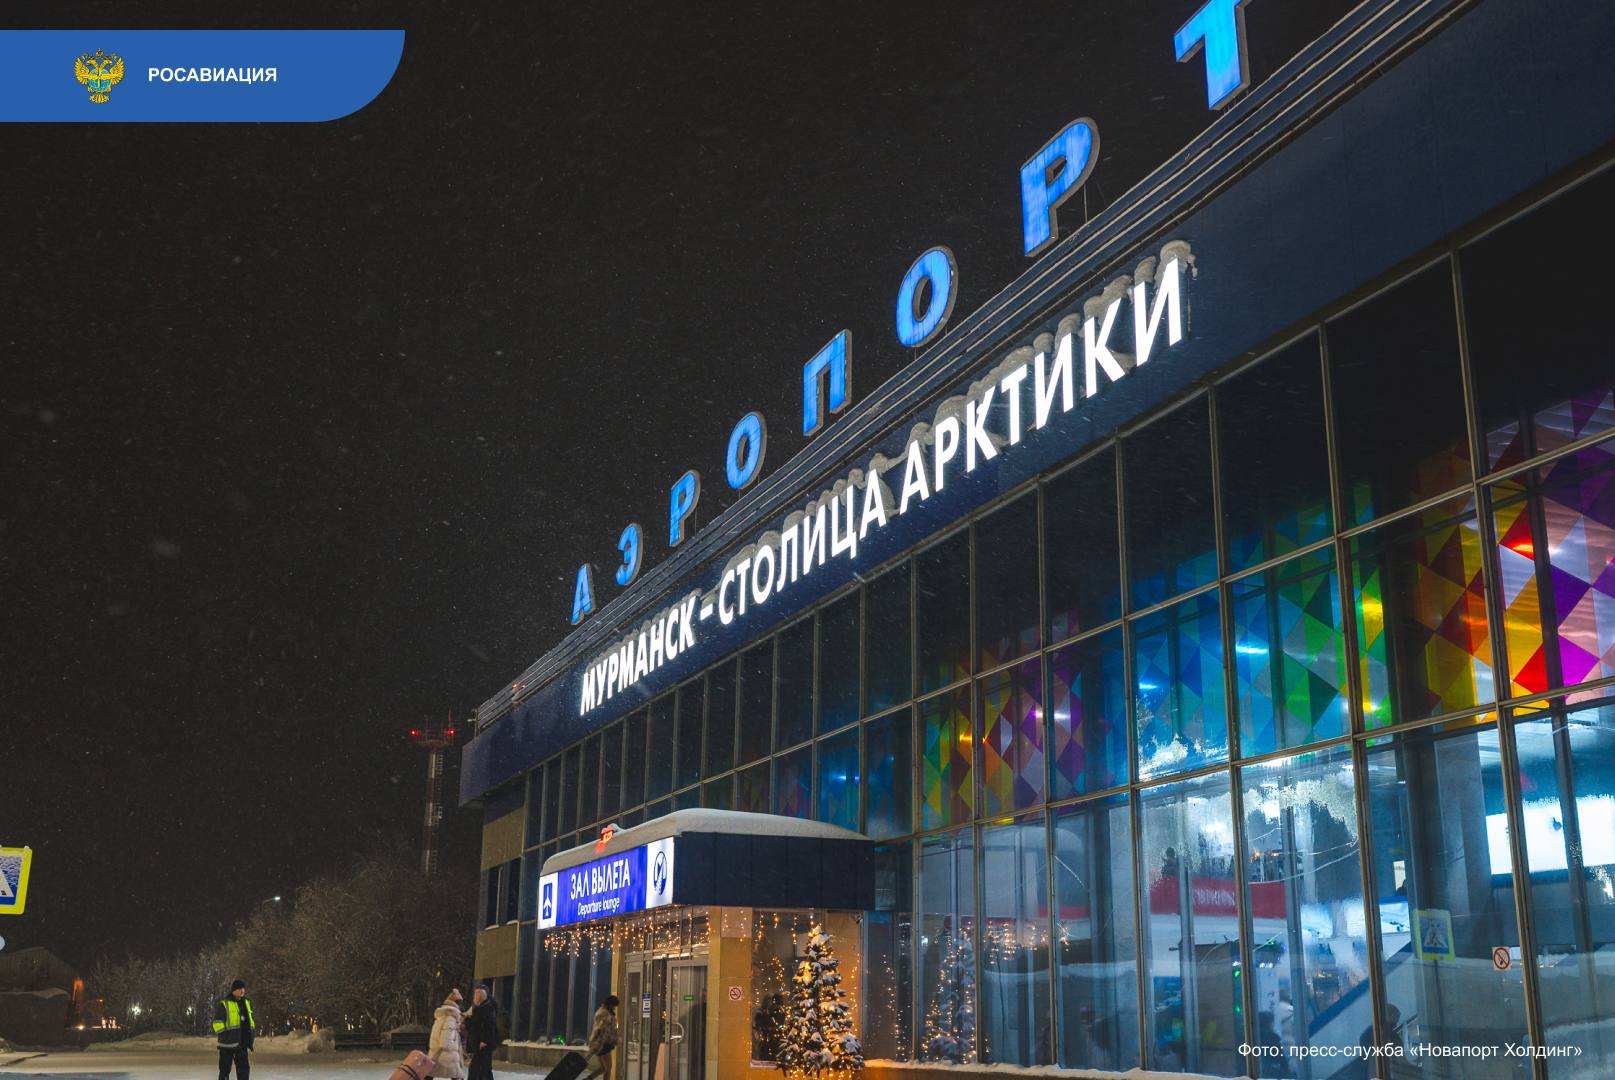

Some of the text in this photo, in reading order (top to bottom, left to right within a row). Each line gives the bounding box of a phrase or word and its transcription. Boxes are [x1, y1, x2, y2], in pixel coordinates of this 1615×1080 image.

[571, 0, 1249, 625] АЭРОПОРТ
[899, 257, 1183, 516] АРКТИКИ
[570, 857, 631, 900] ЗАЛ ВЫЛЕТА
[577, 896, 620, 919] Departure lounge
